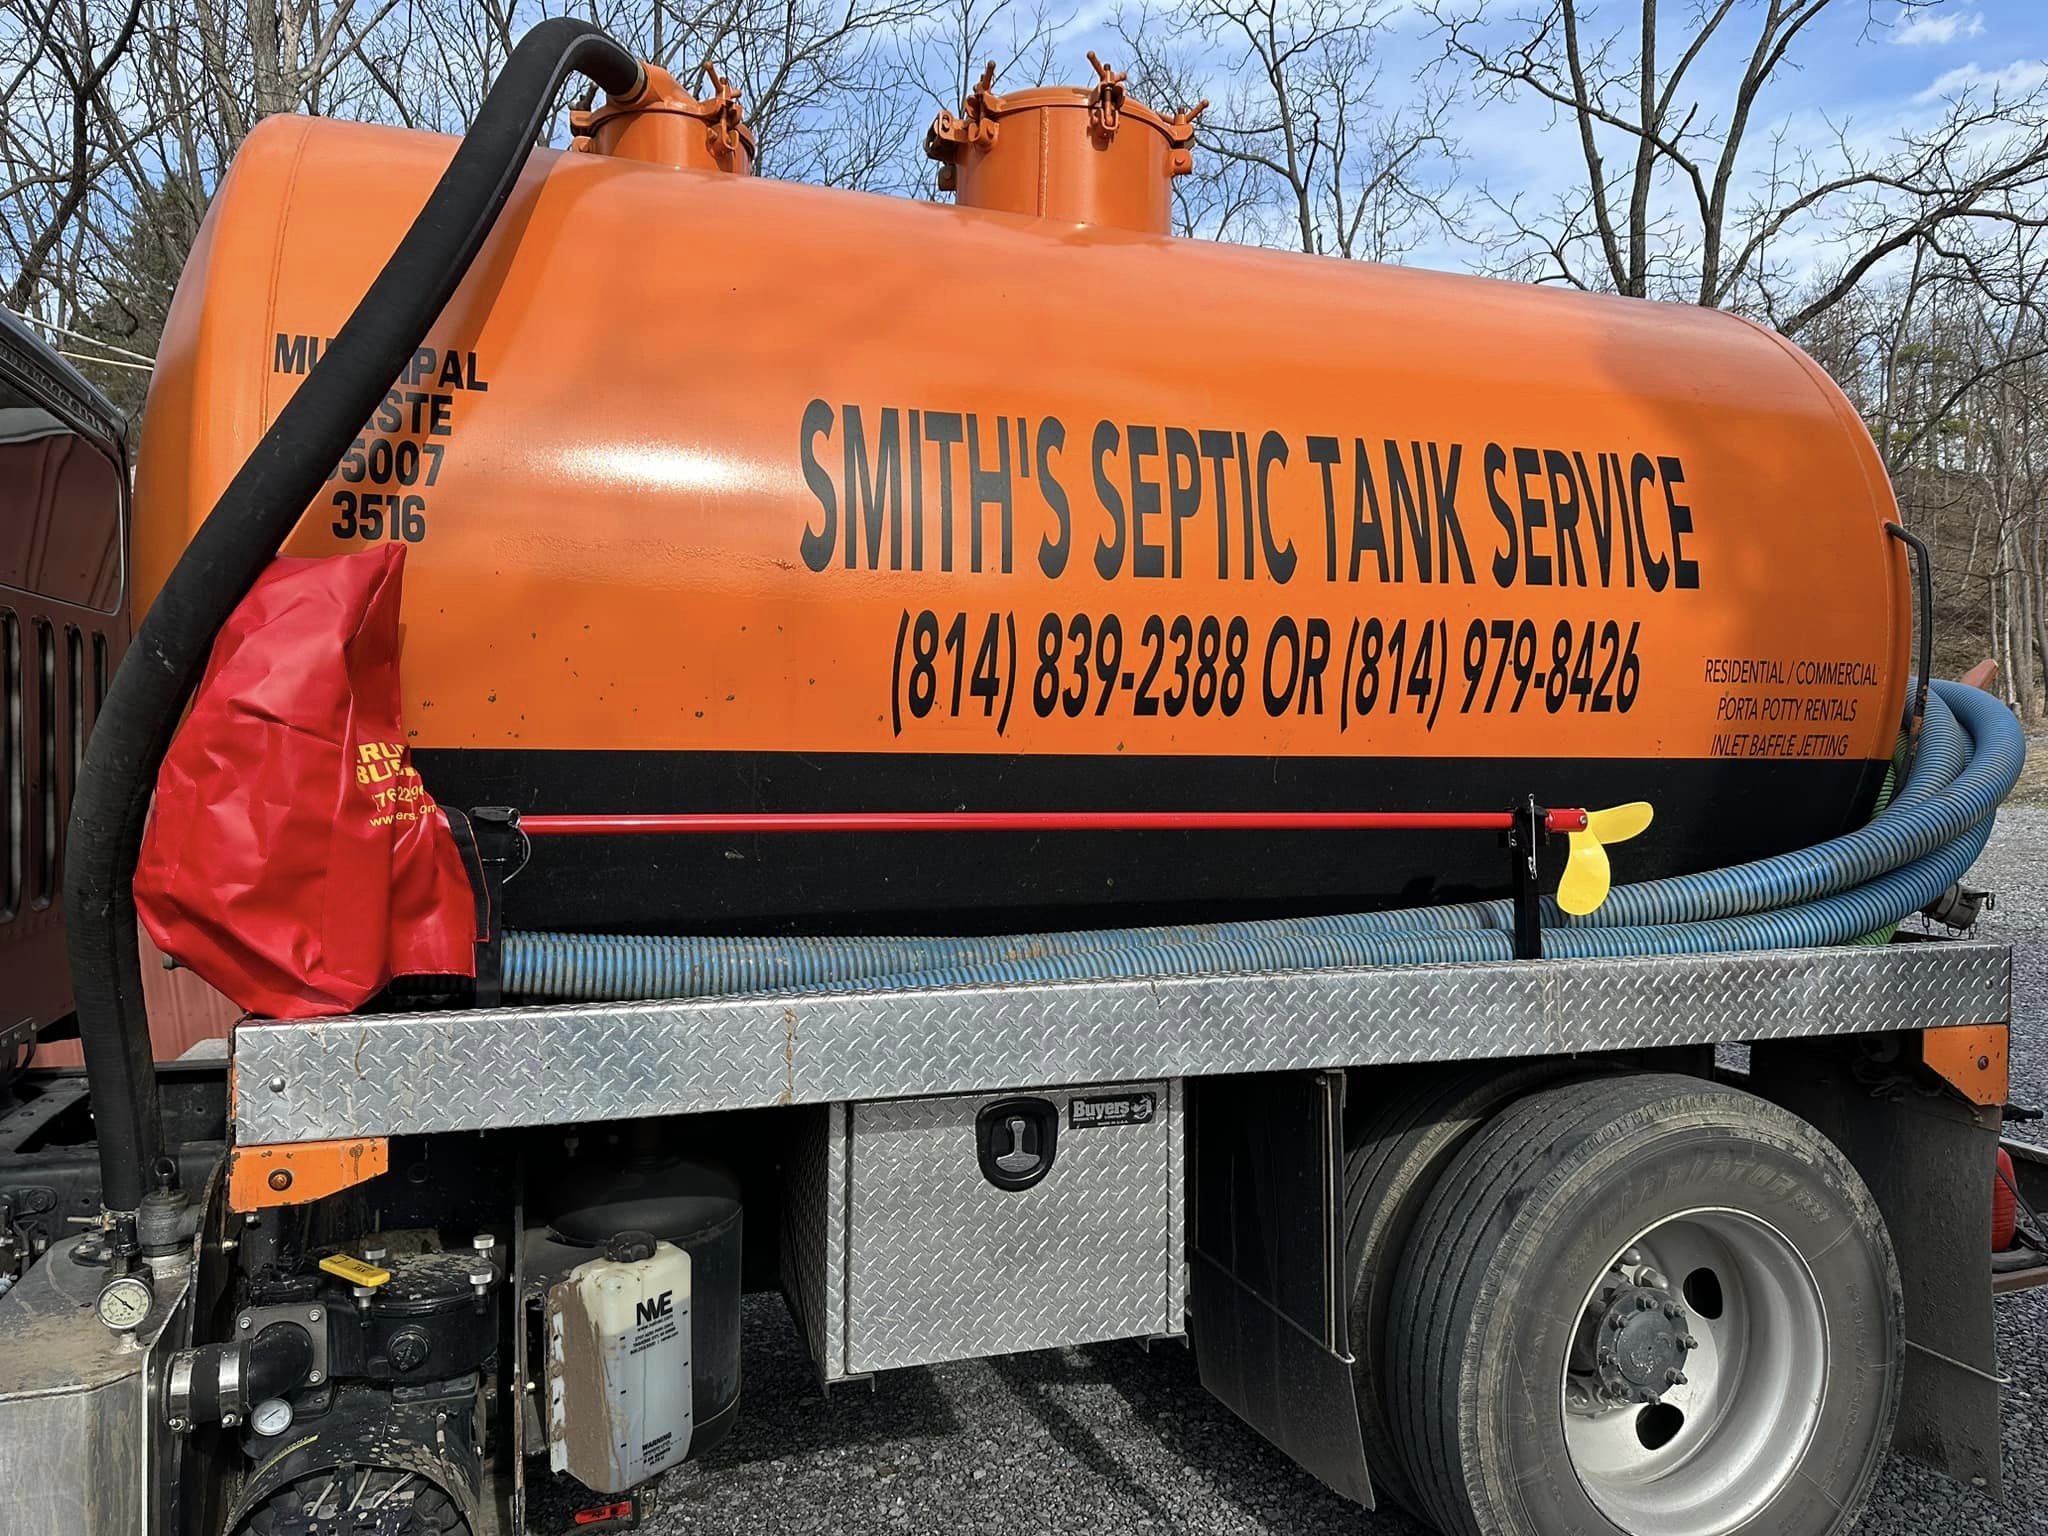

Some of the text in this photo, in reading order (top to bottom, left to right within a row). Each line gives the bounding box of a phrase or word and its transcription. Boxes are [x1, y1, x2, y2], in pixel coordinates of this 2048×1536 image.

[327, 438, 445, 486] 5007
[800, 398, 1700, 592] SMITH'S SEPTIC TANK SERVICE
[331, 490, 426, 543] 3516
[892, 608, 1641, 738] (814) 839-2388 OR (814) 979-8426
[1704, 658, 1878, 686] RESIDENTIAL / COMMERCIAL
[1716, 697, 1858, 722] PORTA POTTY RENTALS
[1710, 733, 1849, 757] INLET BAFFLE JETTING
[1073, 1100, 1130, 1120] Buyers
[636, 1289, 673, 1326] NVE
